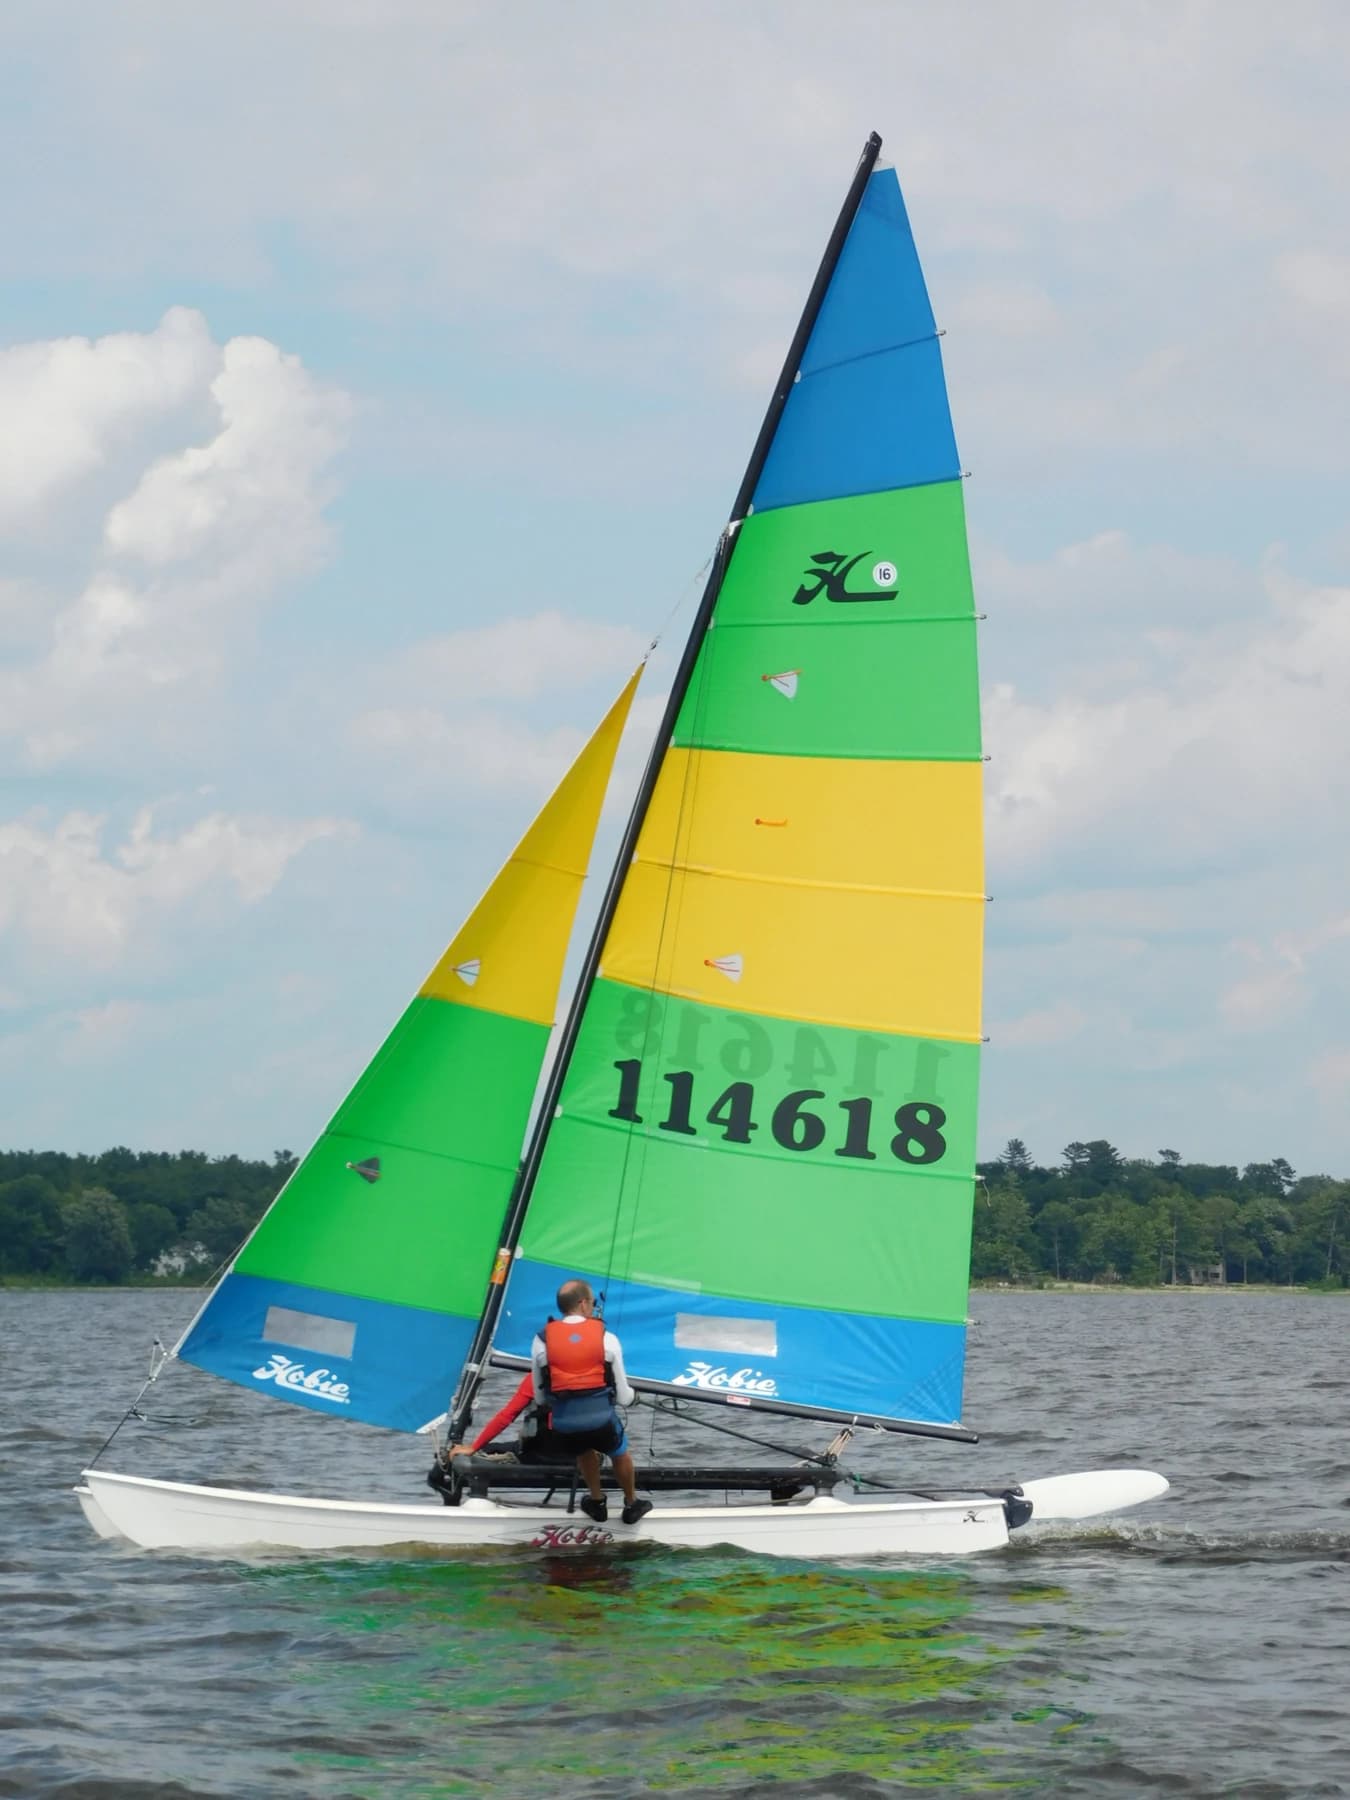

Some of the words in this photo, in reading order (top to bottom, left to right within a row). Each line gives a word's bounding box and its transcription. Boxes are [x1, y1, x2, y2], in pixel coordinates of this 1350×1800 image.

[879, 568, 891, 580] 16
[607, 1059, 947, 1165] 114618
[252, 1354, 351, 1404] Hobie
[672, 1361, 779, 1397] Hobie
